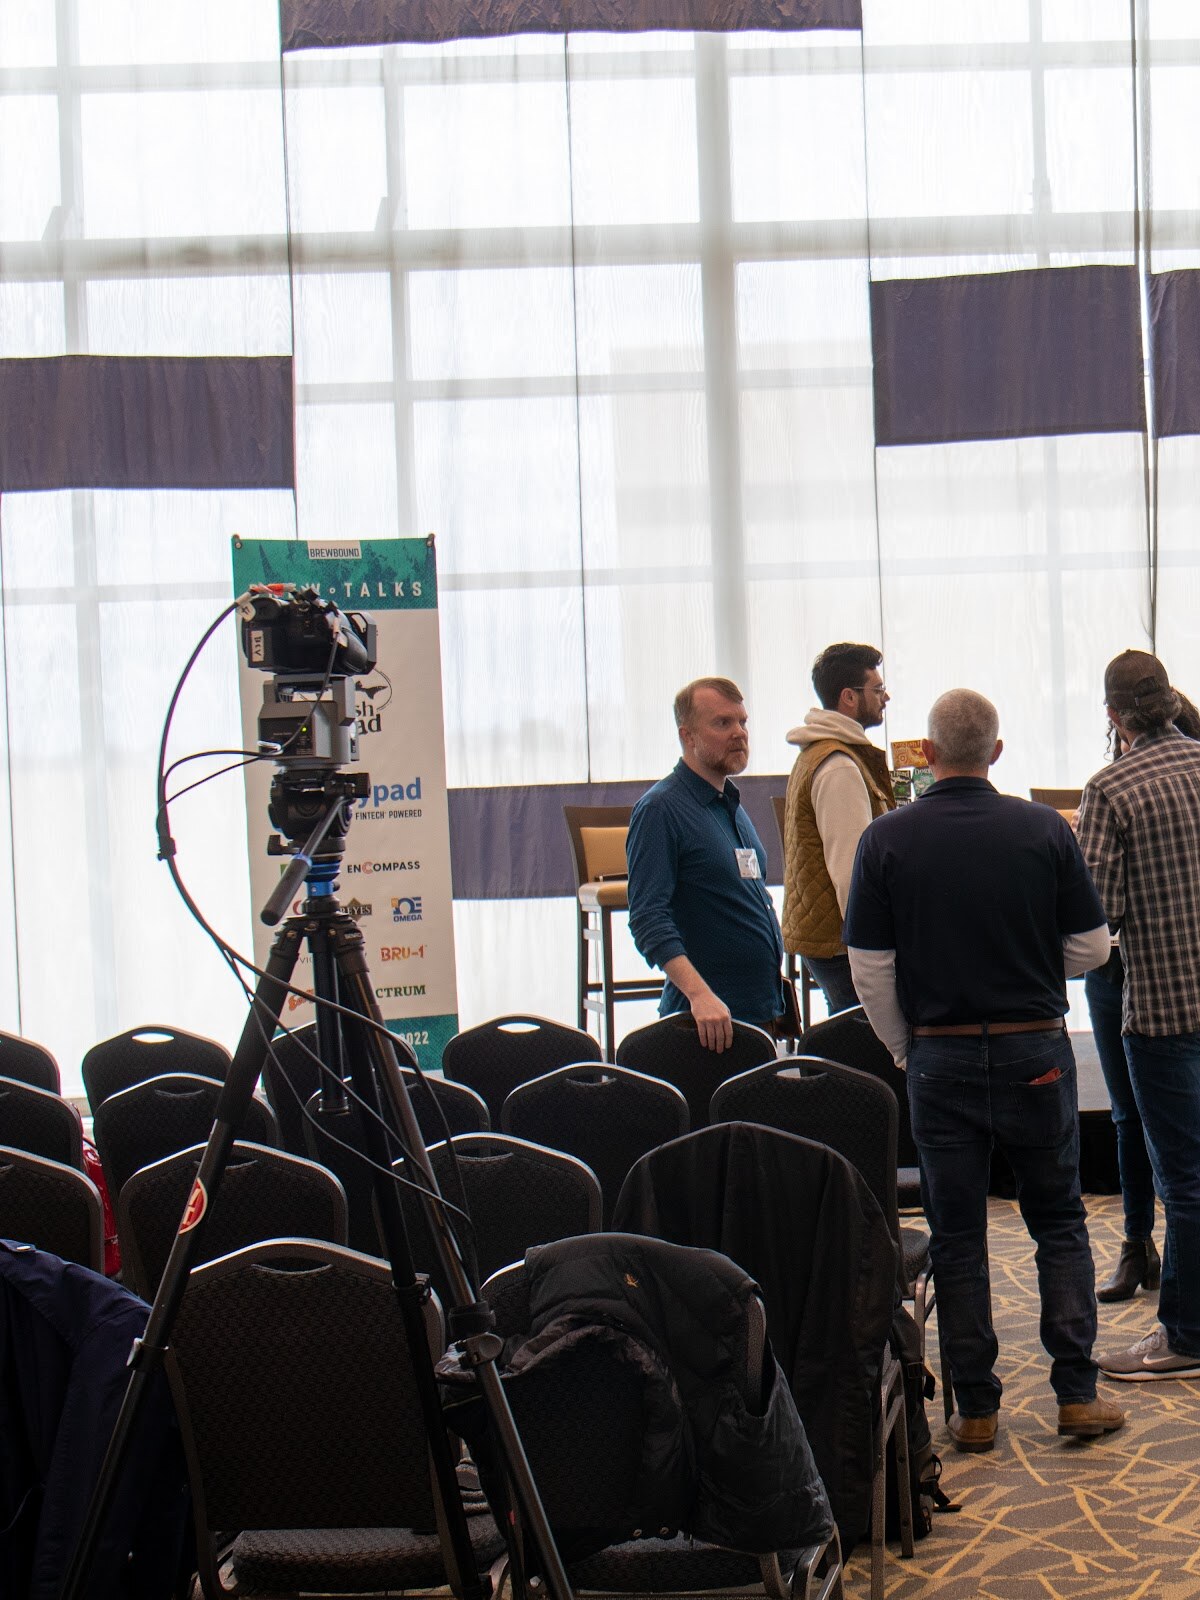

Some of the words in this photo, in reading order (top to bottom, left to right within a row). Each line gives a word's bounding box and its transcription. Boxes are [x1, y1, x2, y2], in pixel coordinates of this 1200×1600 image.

[309, 547, 360, 559] BREWBOUND
[345, 581, 423, 598] TALKS
[355, 811, 385, 821] FINTECH
[388, 809, 423, 819] POWERED
[346, 860, 421, 875] ENCOMPASS
[393, 913, 423, 923] OMEGA
[380, 944, 425, 962] BRU-1
[375, 984, 426, 999] CTRUM
